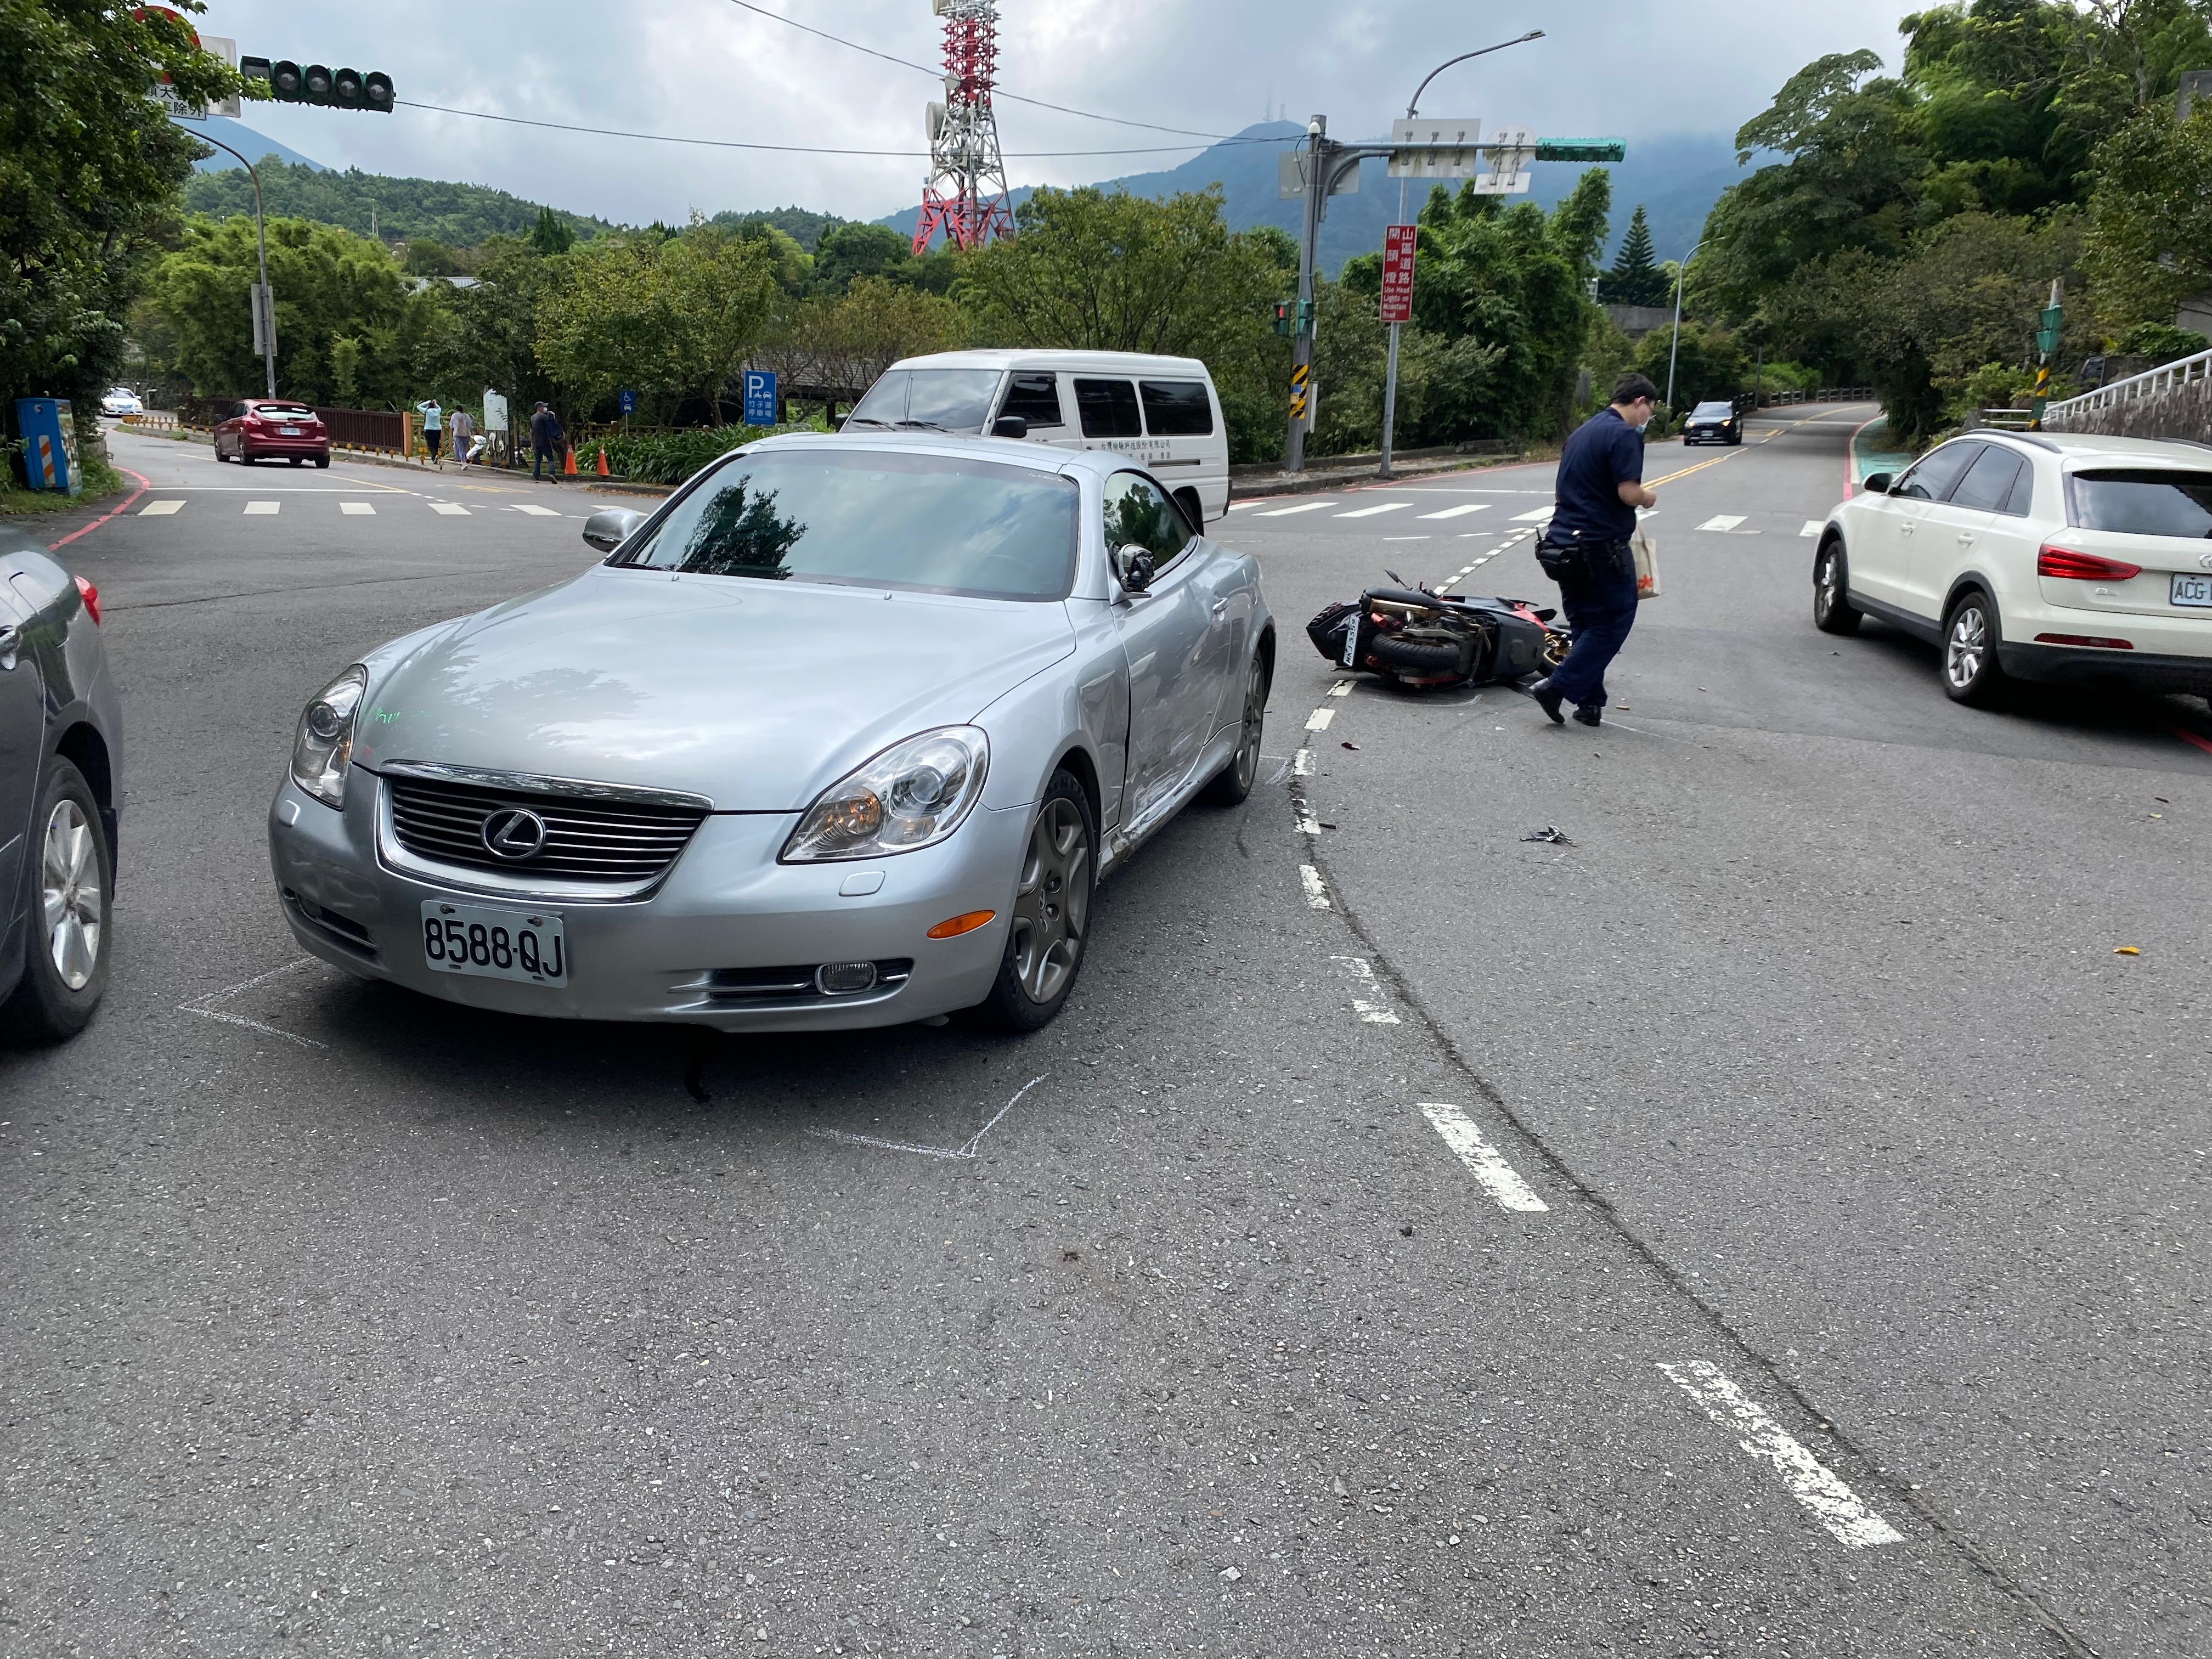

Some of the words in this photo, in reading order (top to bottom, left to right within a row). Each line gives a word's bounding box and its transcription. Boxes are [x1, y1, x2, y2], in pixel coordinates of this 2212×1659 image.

[1385, 228, 1400, 284] 開頭燈
[1398, 227, 1413, 284] 山區道路
[1384, 295, 1400, 303] Lights
[748, 375, 764, 398] P
[748, 409, 772, 417] 停車場
[425, 917, 563, 977] 8588-QJ
